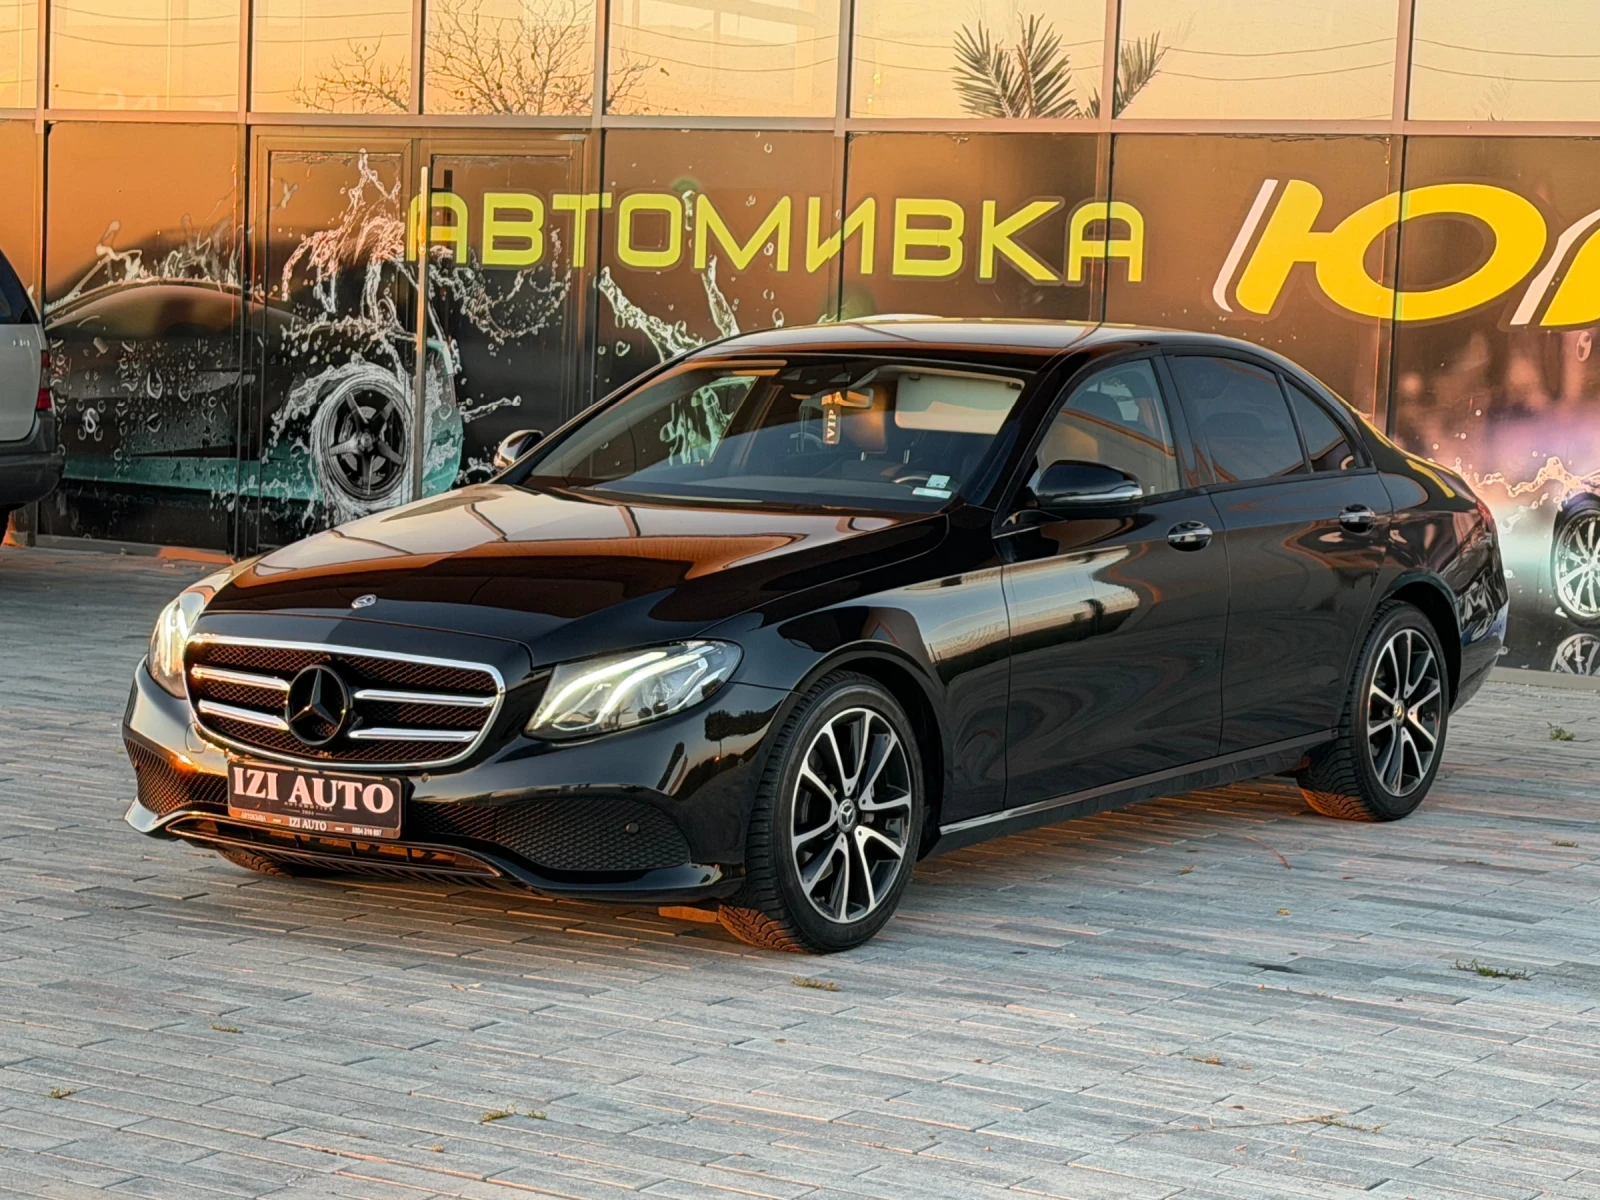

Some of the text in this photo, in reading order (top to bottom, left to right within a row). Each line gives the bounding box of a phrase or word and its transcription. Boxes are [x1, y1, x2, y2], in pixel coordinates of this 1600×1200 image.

[406, 191, 1144, 282] АВТОМИВКА
[827, 409, 836, 439] VIP
[233, 766, 394, 814] IZI AUTO
[289, 816, 327, 832] IZI AUTO
